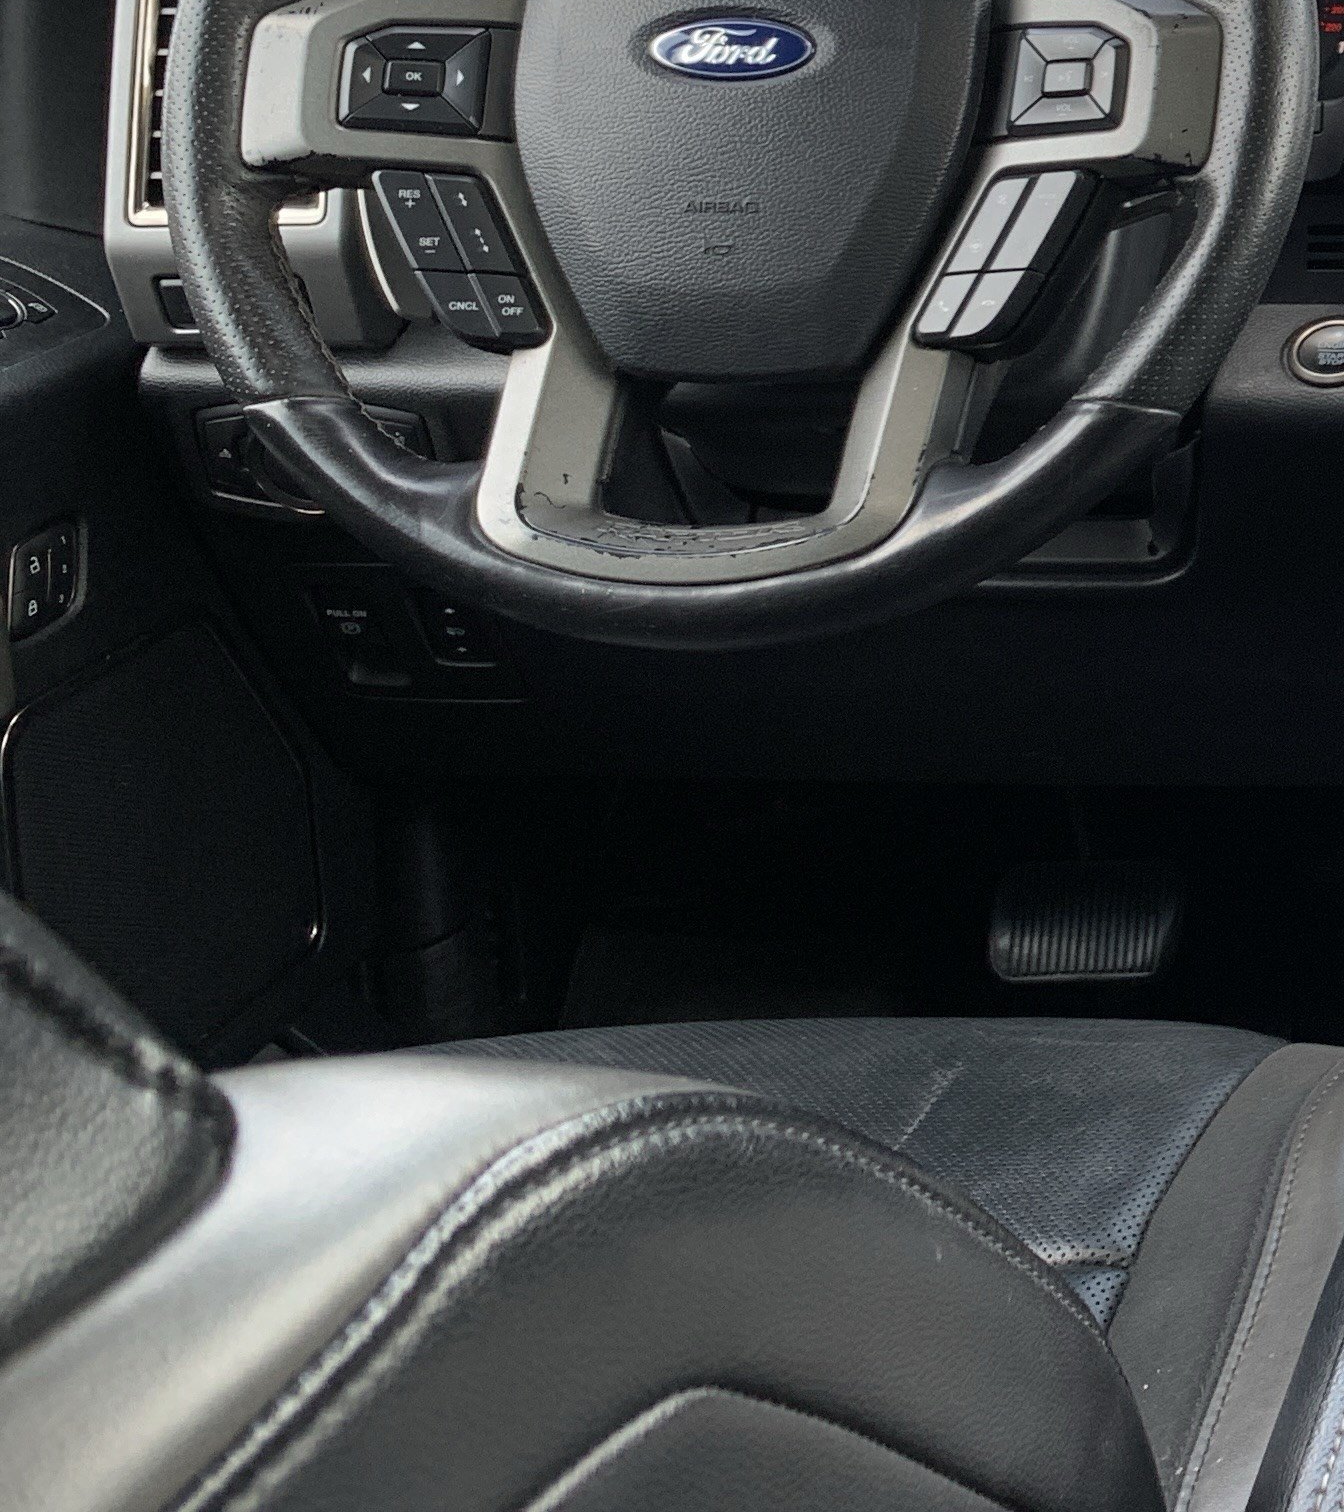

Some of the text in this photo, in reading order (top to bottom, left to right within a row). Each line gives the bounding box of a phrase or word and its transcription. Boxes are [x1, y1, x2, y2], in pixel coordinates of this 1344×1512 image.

[672, 26, 778, 66] Ford
[405, 71, 423, 82] OK
[398, 189, 421, 199] RES
[684, 201, 759, 214] AIRBAG
[419, 237, 440, 247] SET
[498, 294, 515, 304] ON
[449, 301, 479, 312] CNCL
[502, 306, 524, 317] OFF
[326, 609, 367, 618] PULL ON
